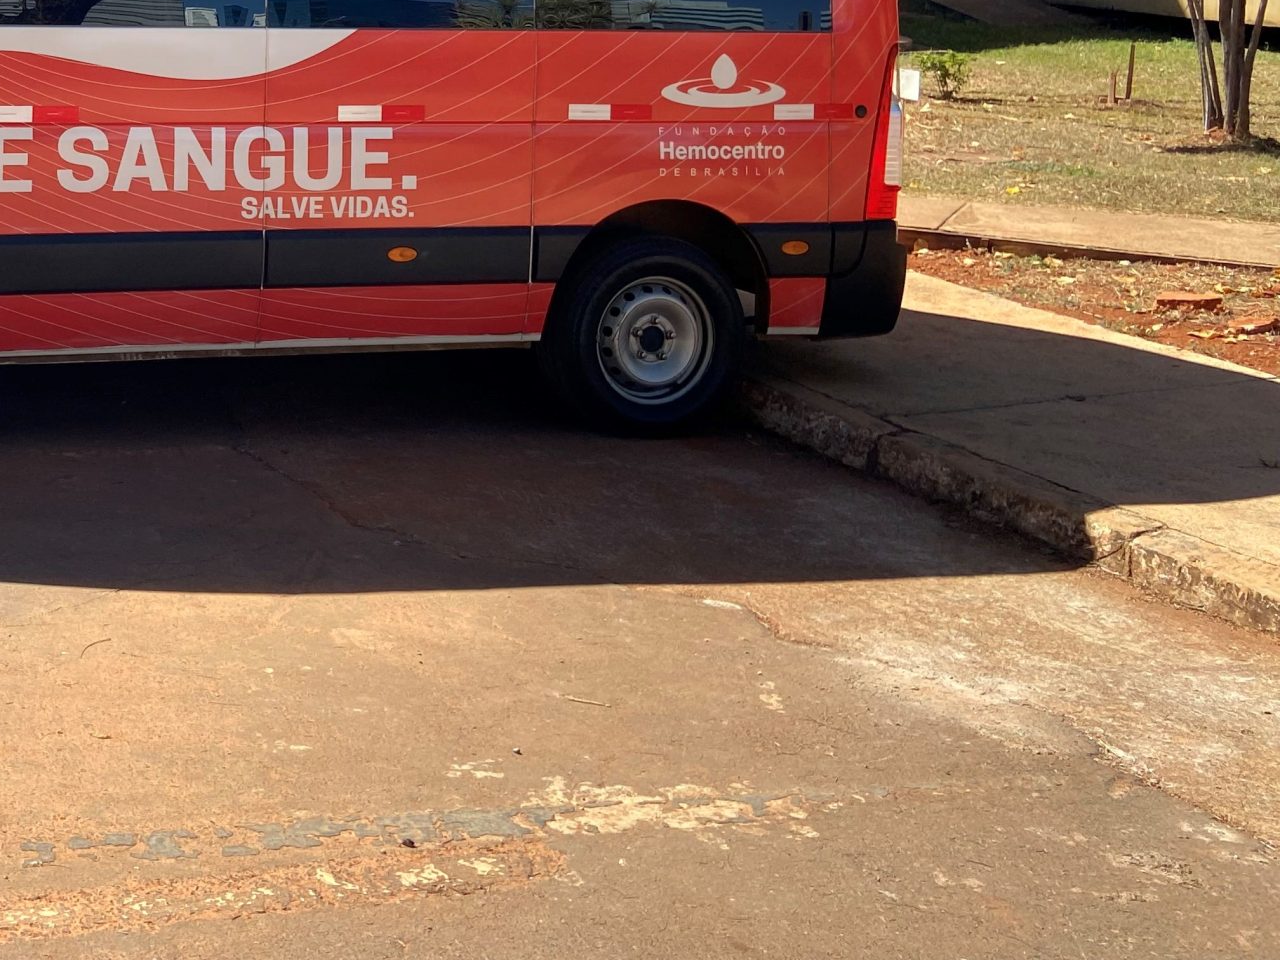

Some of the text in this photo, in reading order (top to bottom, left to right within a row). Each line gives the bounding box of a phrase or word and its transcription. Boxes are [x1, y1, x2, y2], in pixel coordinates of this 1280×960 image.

[658, 125, 786, 137] FUNDAÇÃO
[56, 125, 418, 193] SANGUE.
[659, 141, 785, 160] Hemocentro
[240, 195, 415, 220] SALVE VIDAS.
